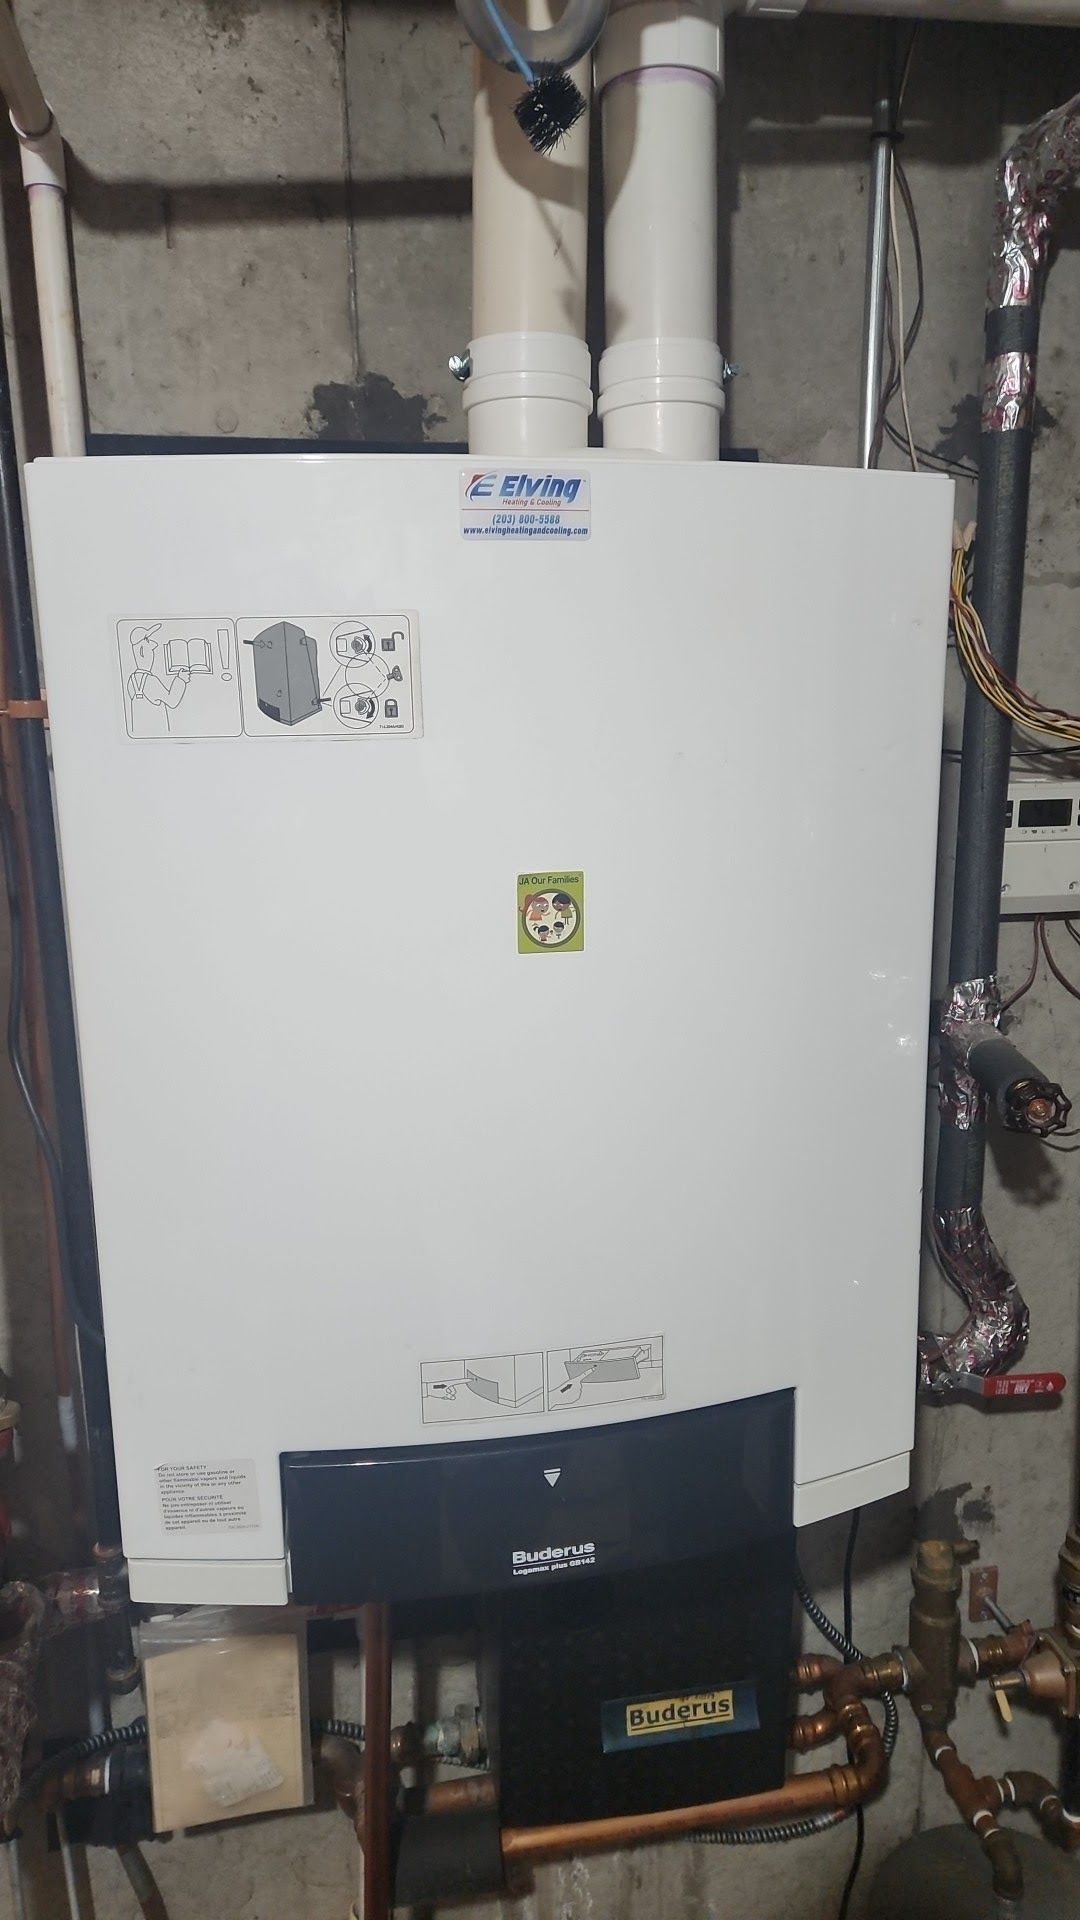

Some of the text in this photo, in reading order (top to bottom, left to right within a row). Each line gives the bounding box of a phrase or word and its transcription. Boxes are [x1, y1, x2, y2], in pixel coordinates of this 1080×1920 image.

[499, 474, 581, 503] Elving
[536, 499, 562, 507] Cooling
[492, 514, 515, 525] (203)
[463, 526, 588, 536] www.elvingheatingandcooling.com
[519, 875, 580, 885] JA Our Families
[512, 1542, 595, 1564] Buderus
[513, 1557, 596, 1575] Logamax plus GB142
[629, 1698, 730, 1727] Buderus
